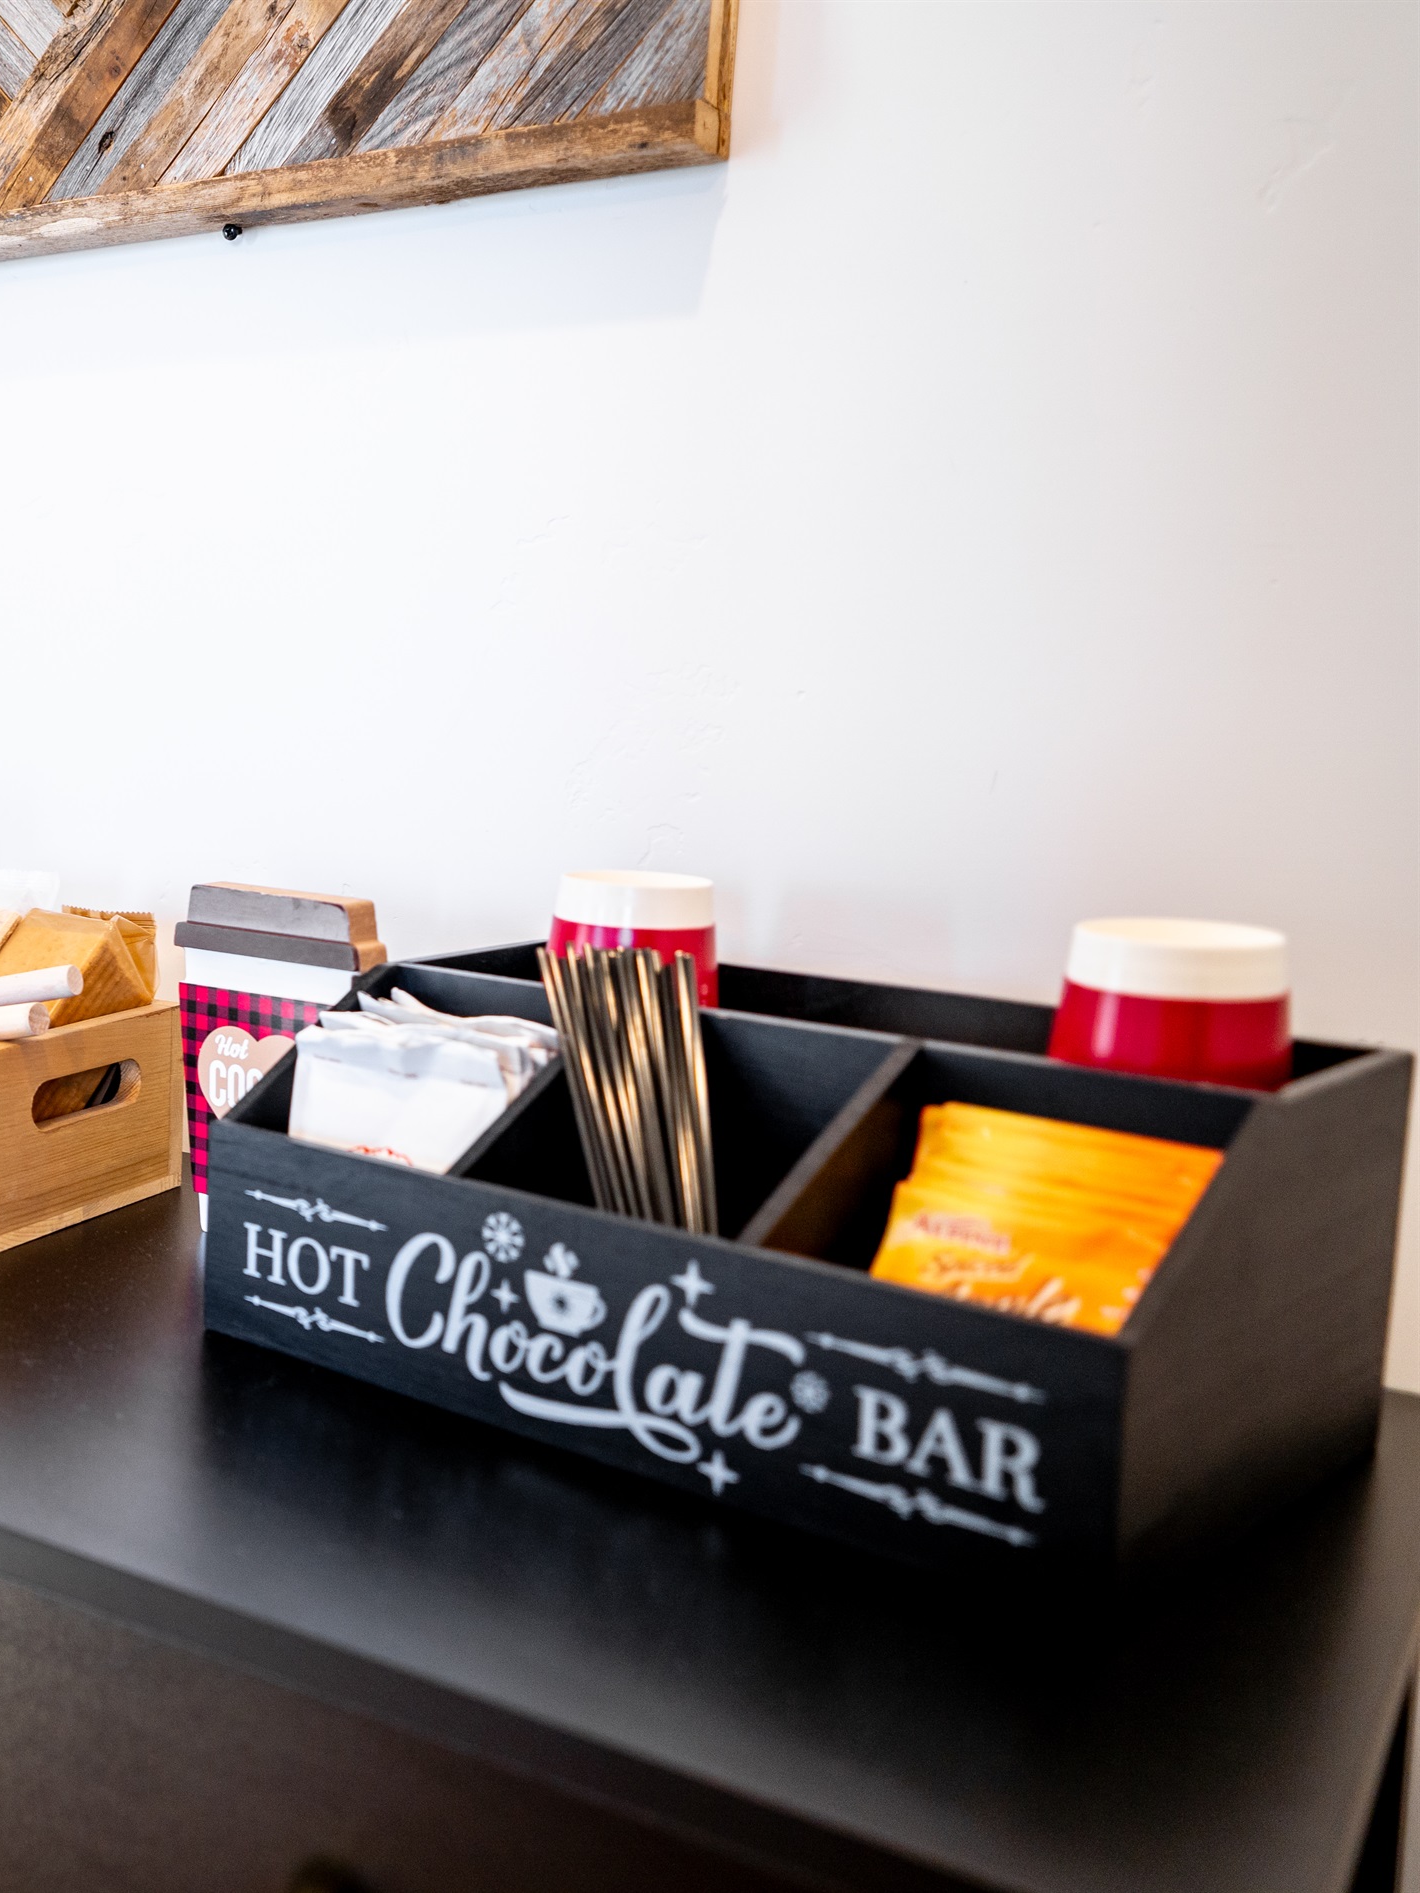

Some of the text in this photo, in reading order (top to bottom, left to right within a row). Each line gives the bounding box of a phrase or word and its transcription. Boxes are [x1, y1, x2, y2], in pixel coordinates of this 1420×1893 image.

[214, 1034, 249, 1060] Hot
[243, 1222, 1046, 1514] HOT Chocolate BAR
